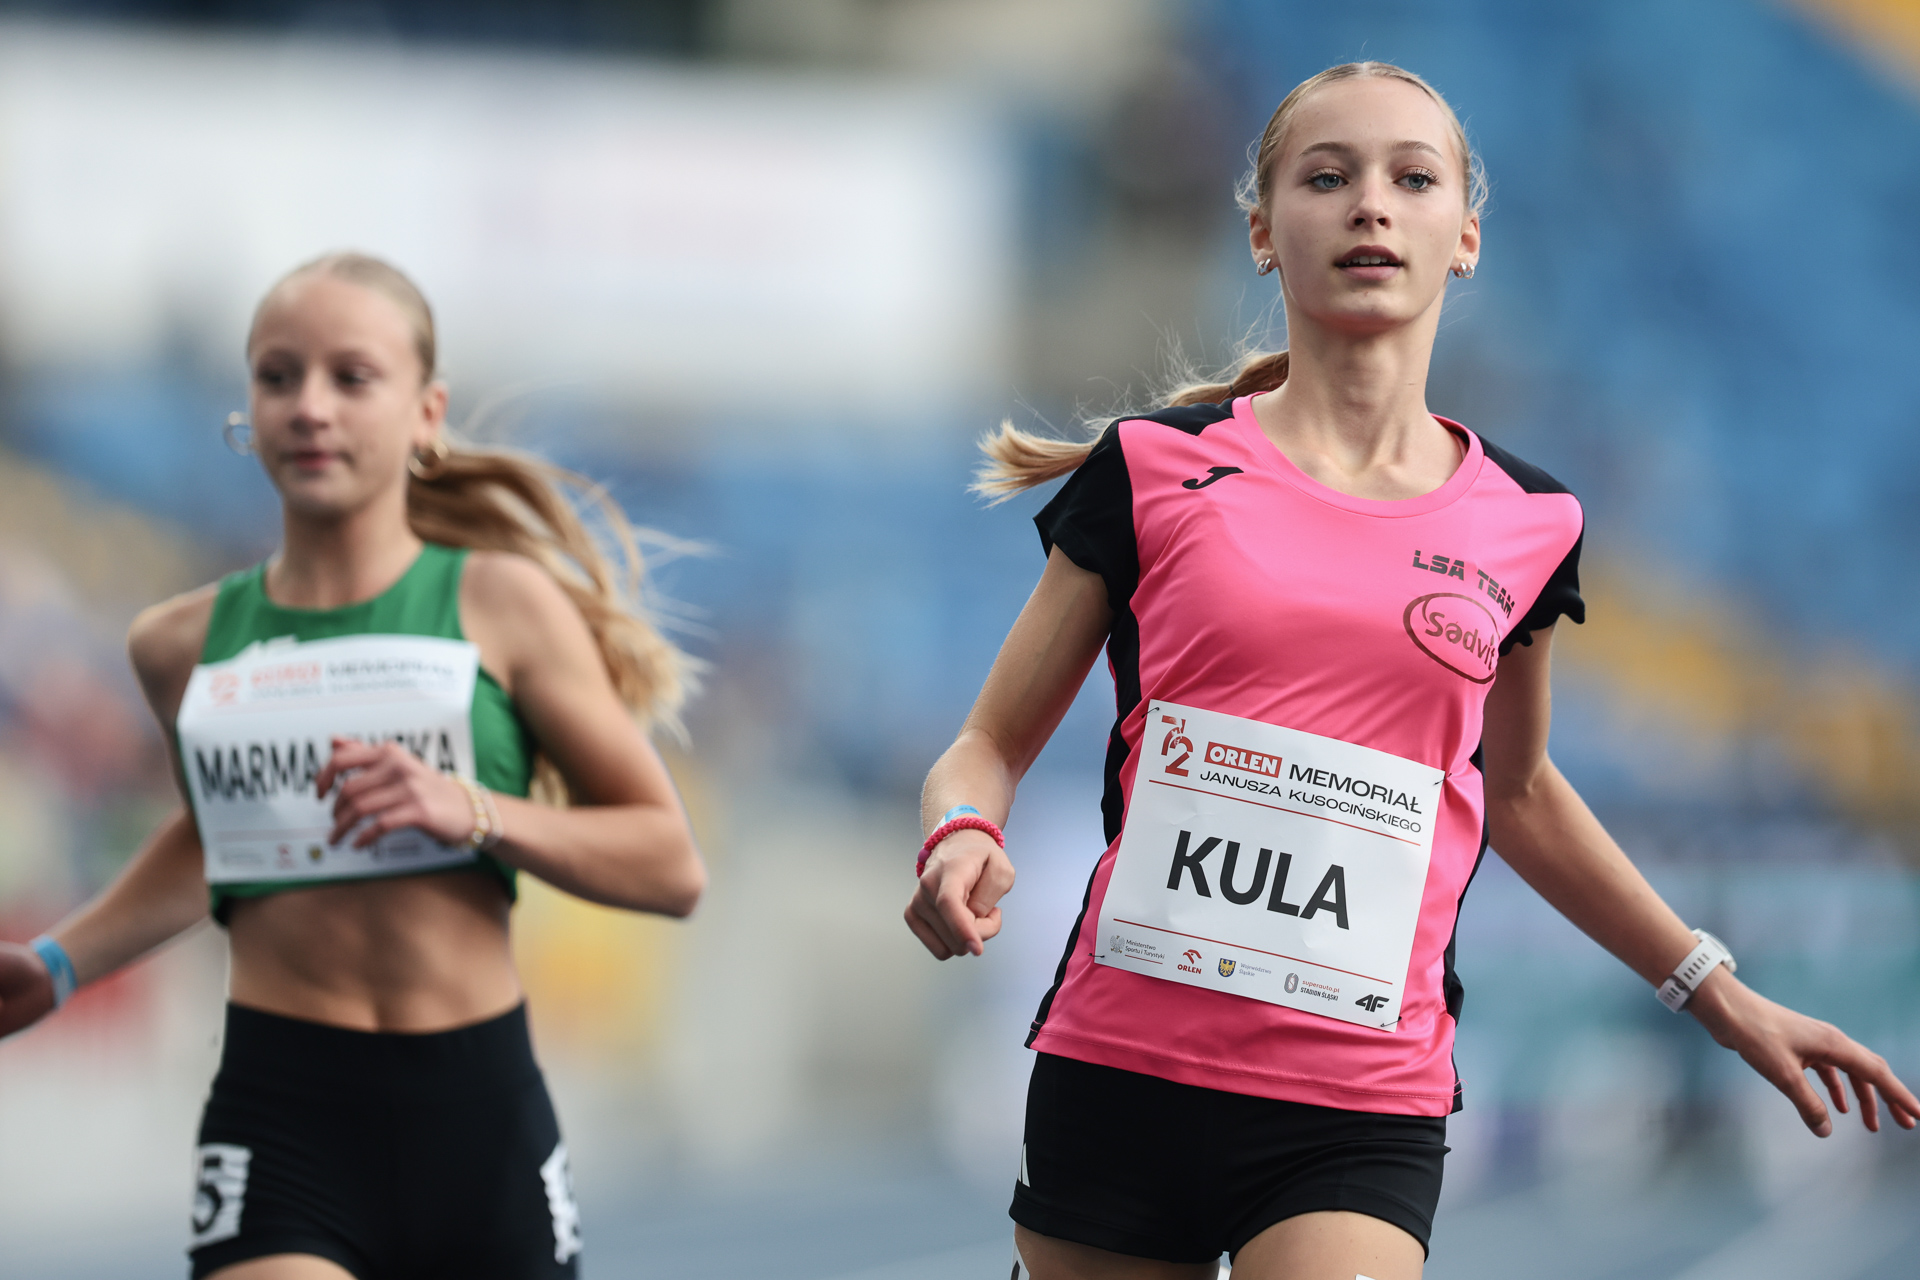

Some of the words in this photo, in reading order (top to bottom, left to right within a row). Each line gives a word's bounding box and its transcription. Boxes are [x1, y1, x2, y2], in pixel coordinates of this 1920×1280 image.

[1412, 549, 1465, 581] LSA
[1477, 569, 1516, 619] TEAM
[1208, 745, 1279, 776] ORLEN
[1289, 764, 1422, 815] MEMORIAŁ
[1199, 771, 1282, 797] JANUSZA
[1288, 789, 1422, 833] KUSOCIŃSKIEGO
[1166, 829, 1350, 930] KULA
[1125, 946, 1141, 954] Sportu
[1144, 949, 1165, 960] Turystyki
[1126, 939, 1157, 951] Ministerstwo
[1177, 963, 1202, 974] ORLEN
[1300, 986, 1321, 997] STADION
[1321, 990, 1339, 1001] ŚLĄSKI
[1302, 980, 1340, 993] superauto.pl
[1355, 994, 1390, 1012] 4F
